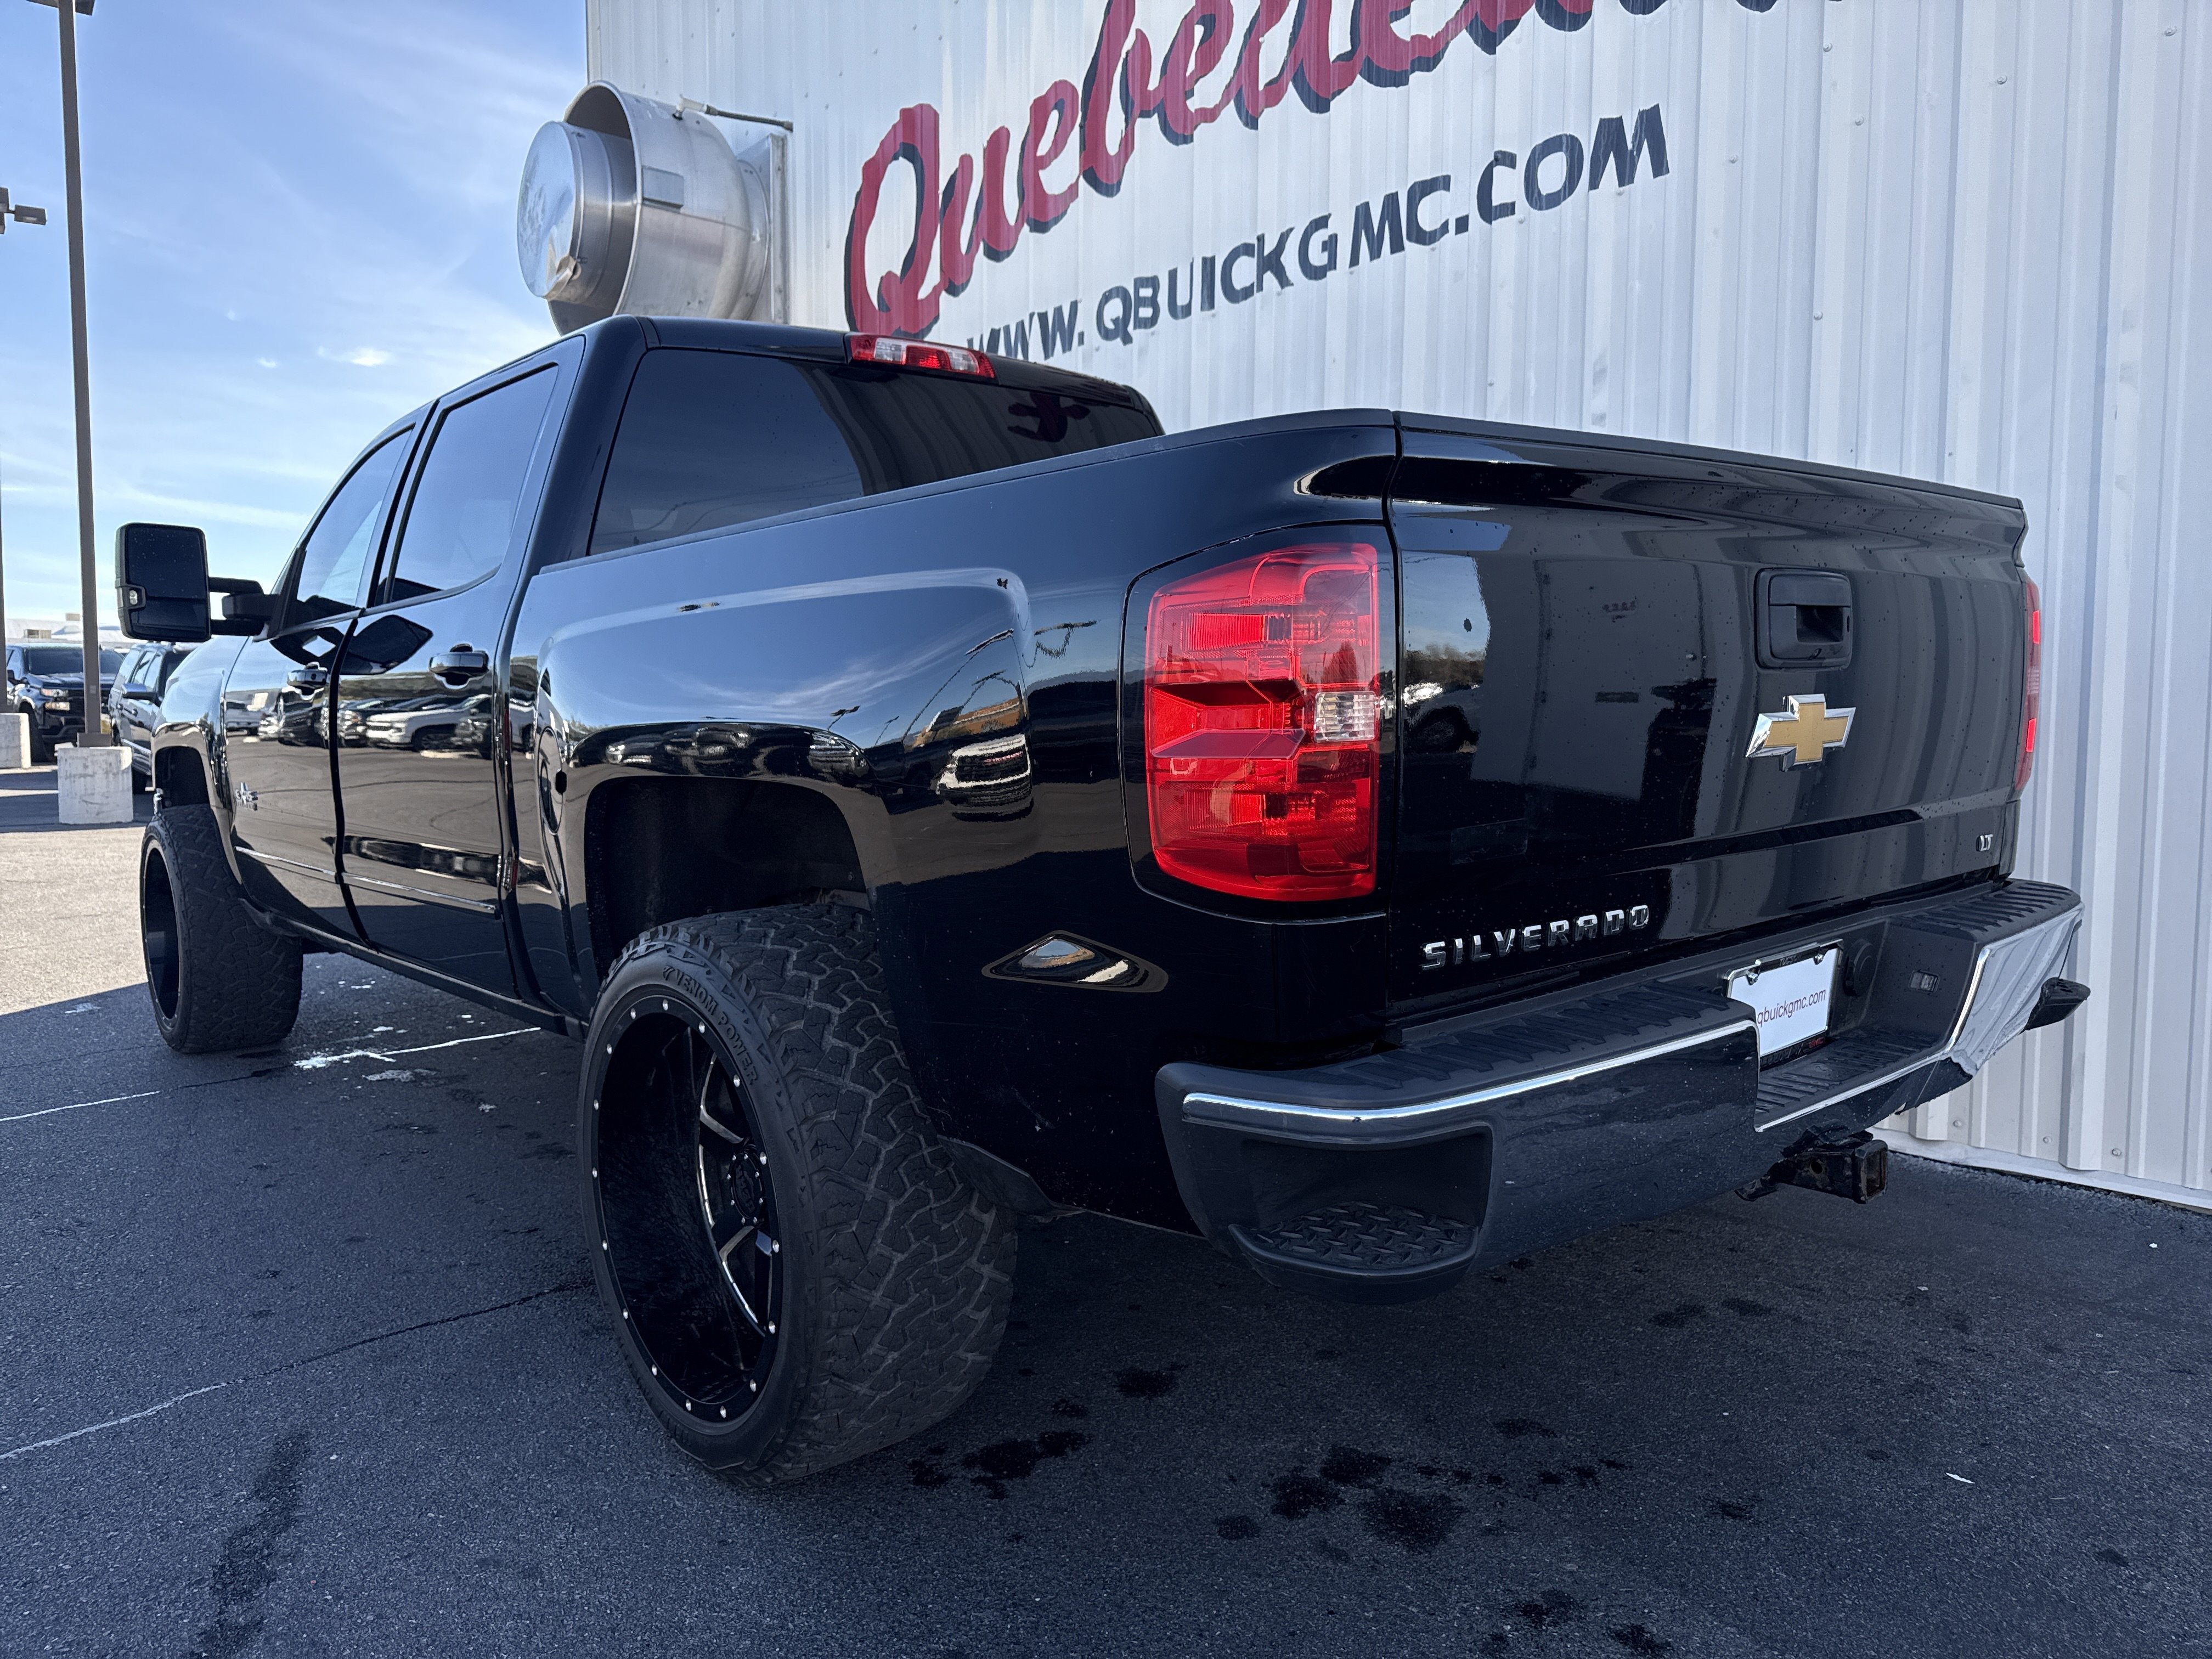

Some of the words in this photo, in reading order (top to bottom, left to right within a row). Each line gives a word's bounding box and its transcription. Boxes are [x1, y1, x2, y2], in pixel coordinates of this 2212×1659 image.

[1978, 834, 1993, 851] LT
[1420, 905, 1649, 970] SILVERADO
[676, 969, 719, 1015] VENOM
[718, 1011, 758, 1086] POWER
[1757, 989, 1826, 1028] qbuickgmc.com
